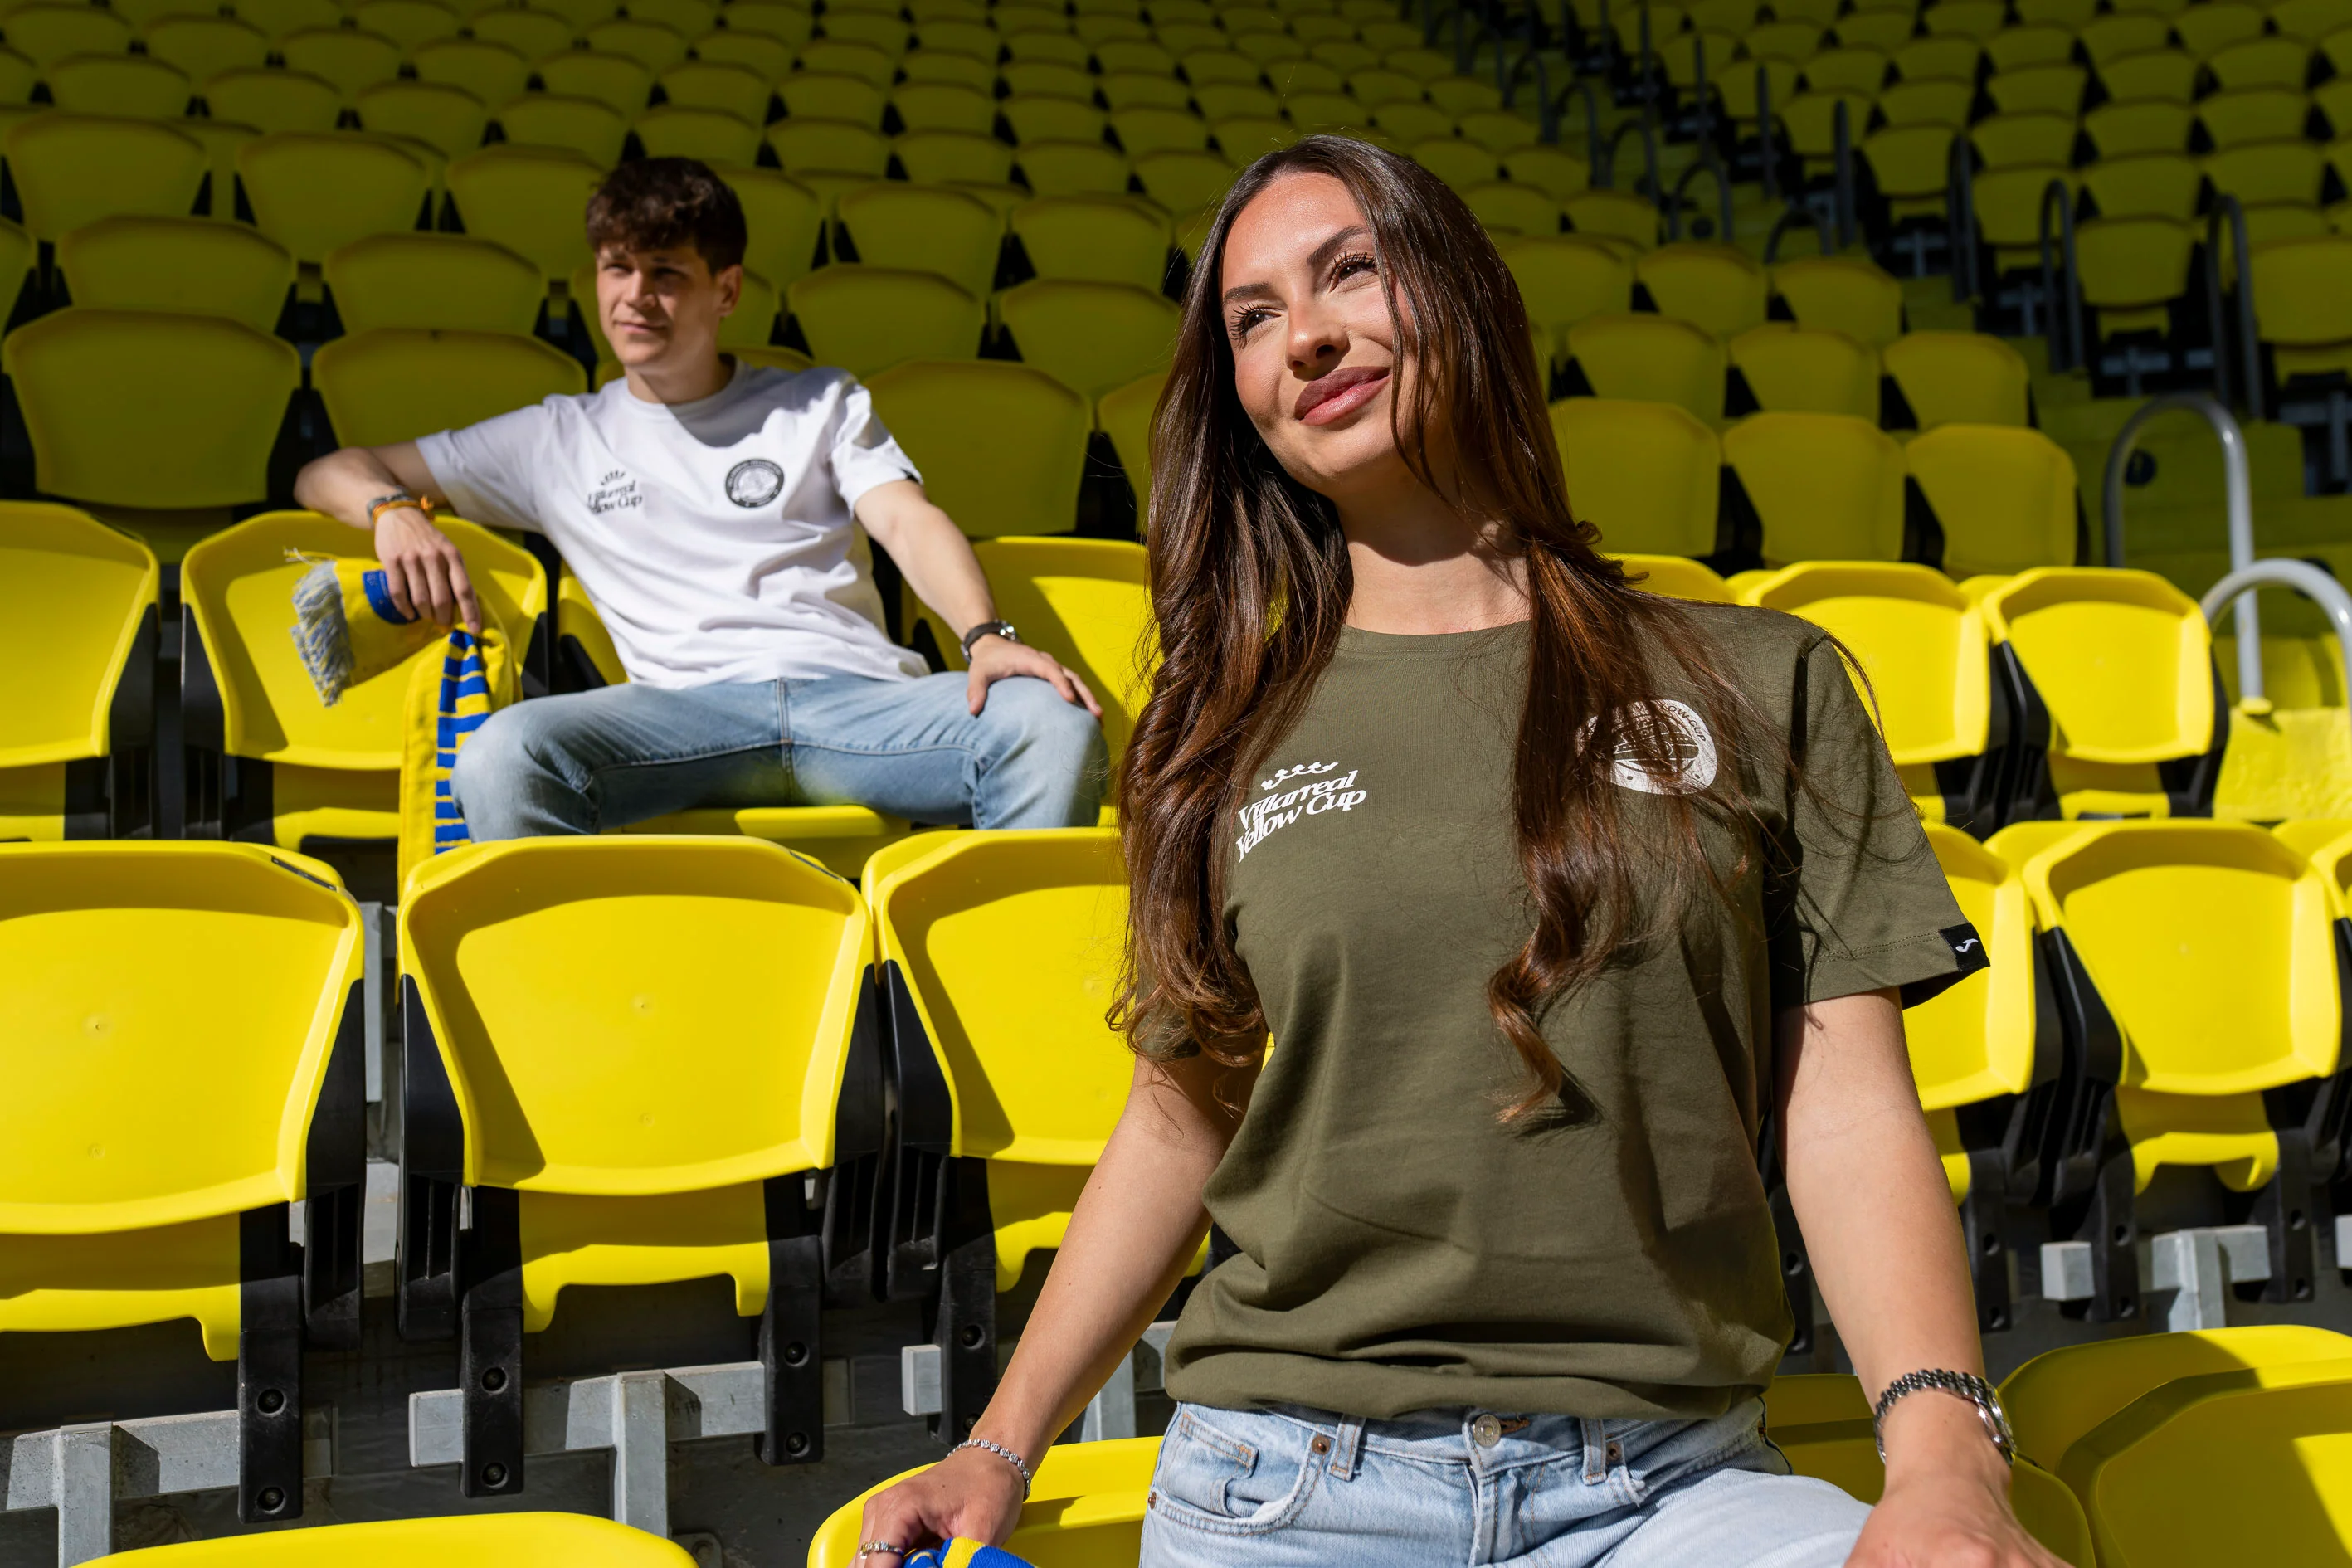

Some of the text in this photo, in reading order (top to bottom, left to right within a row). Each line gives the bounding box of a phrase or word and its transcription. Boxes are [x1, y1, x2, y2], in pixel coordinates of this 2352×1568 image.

[1689, 719, 1707, 742] CUP
[1235, 790, 1367, 864] Yellow Cup
[1238, 770, 1359, 830] Villarreal
